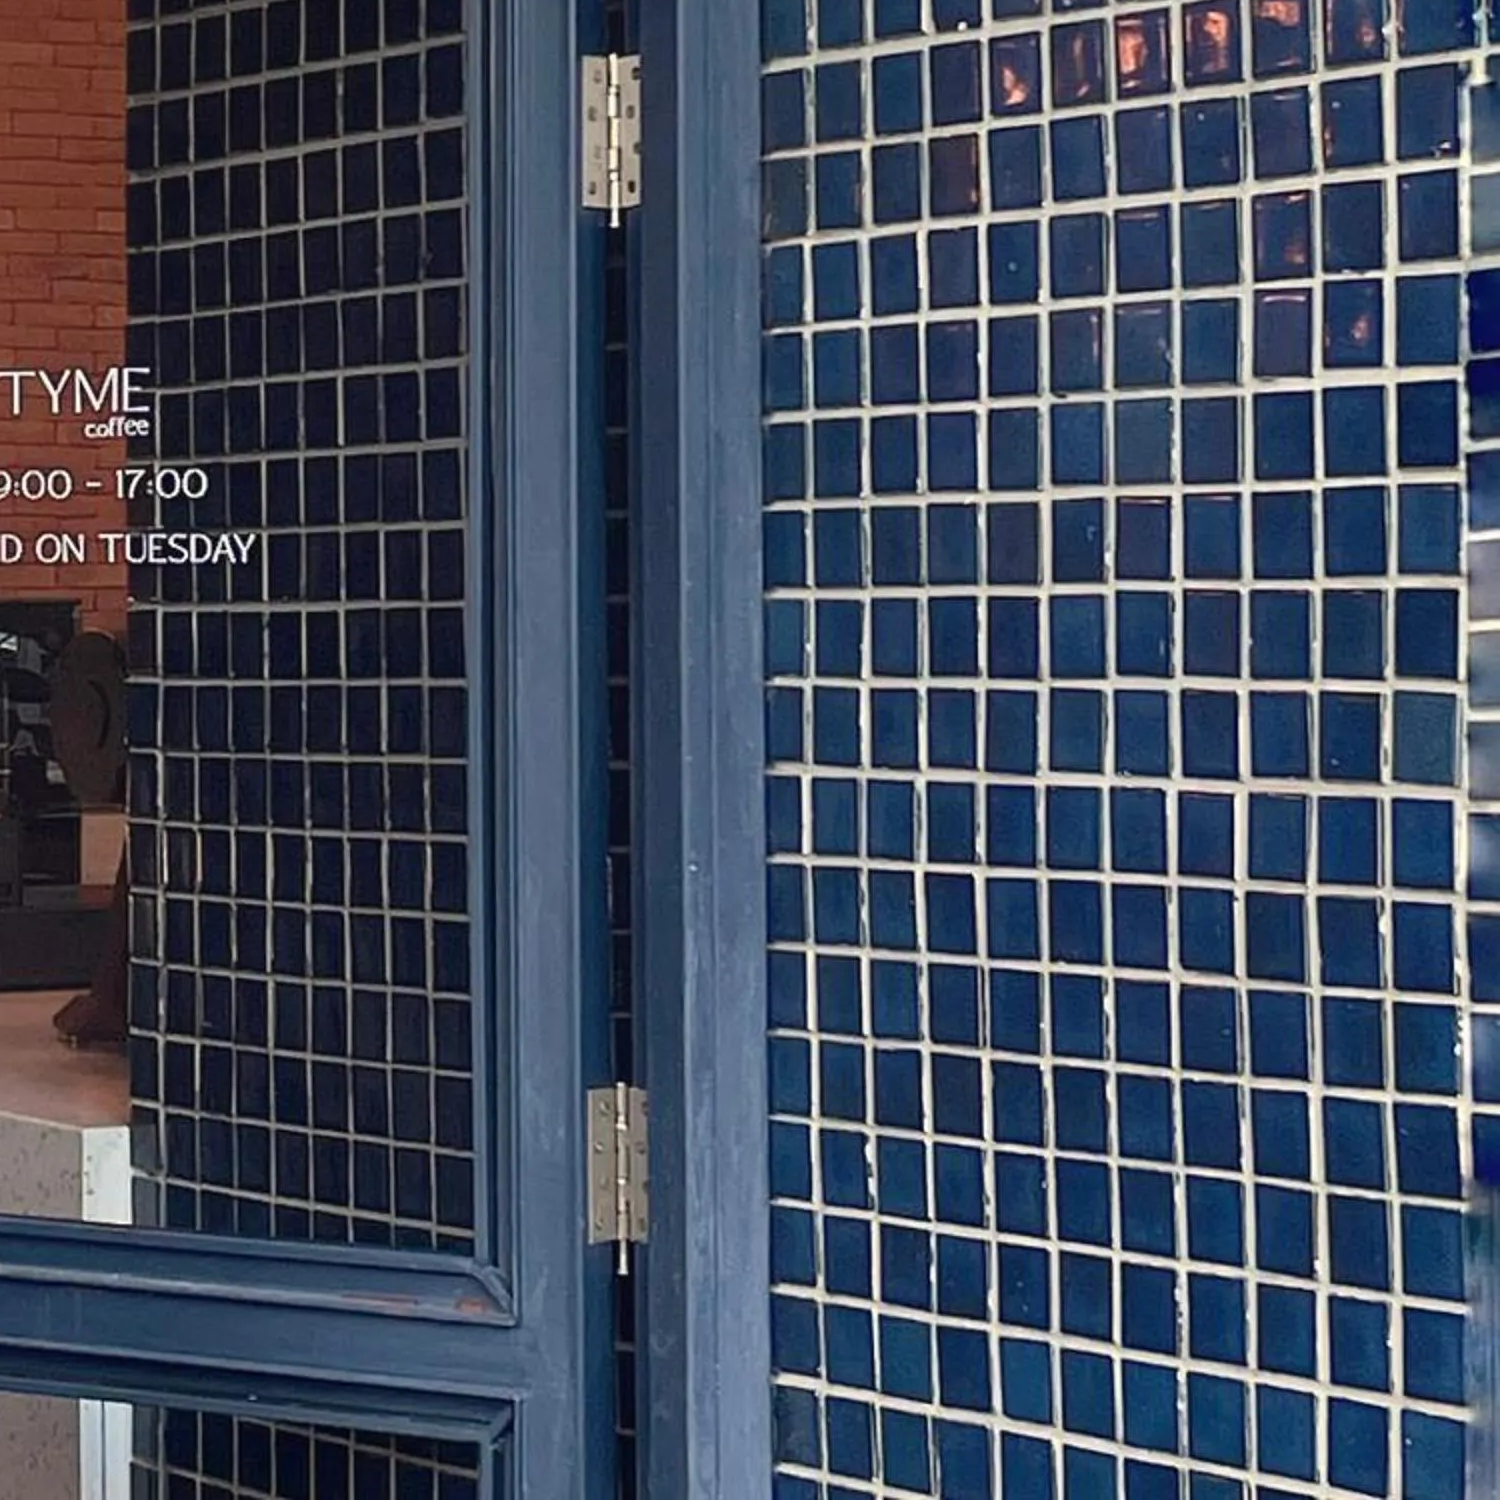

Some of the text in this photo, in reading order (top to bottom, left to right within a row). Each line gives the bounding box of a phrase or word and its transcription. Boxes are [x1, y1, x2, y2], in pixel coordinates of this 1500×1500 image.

[84, 417, 150, 439] coffee
[115, 469, 209, 500] 17:00
[35, 533, 86, 564] ON
[98, 533, 257, 565] TUESDAY
